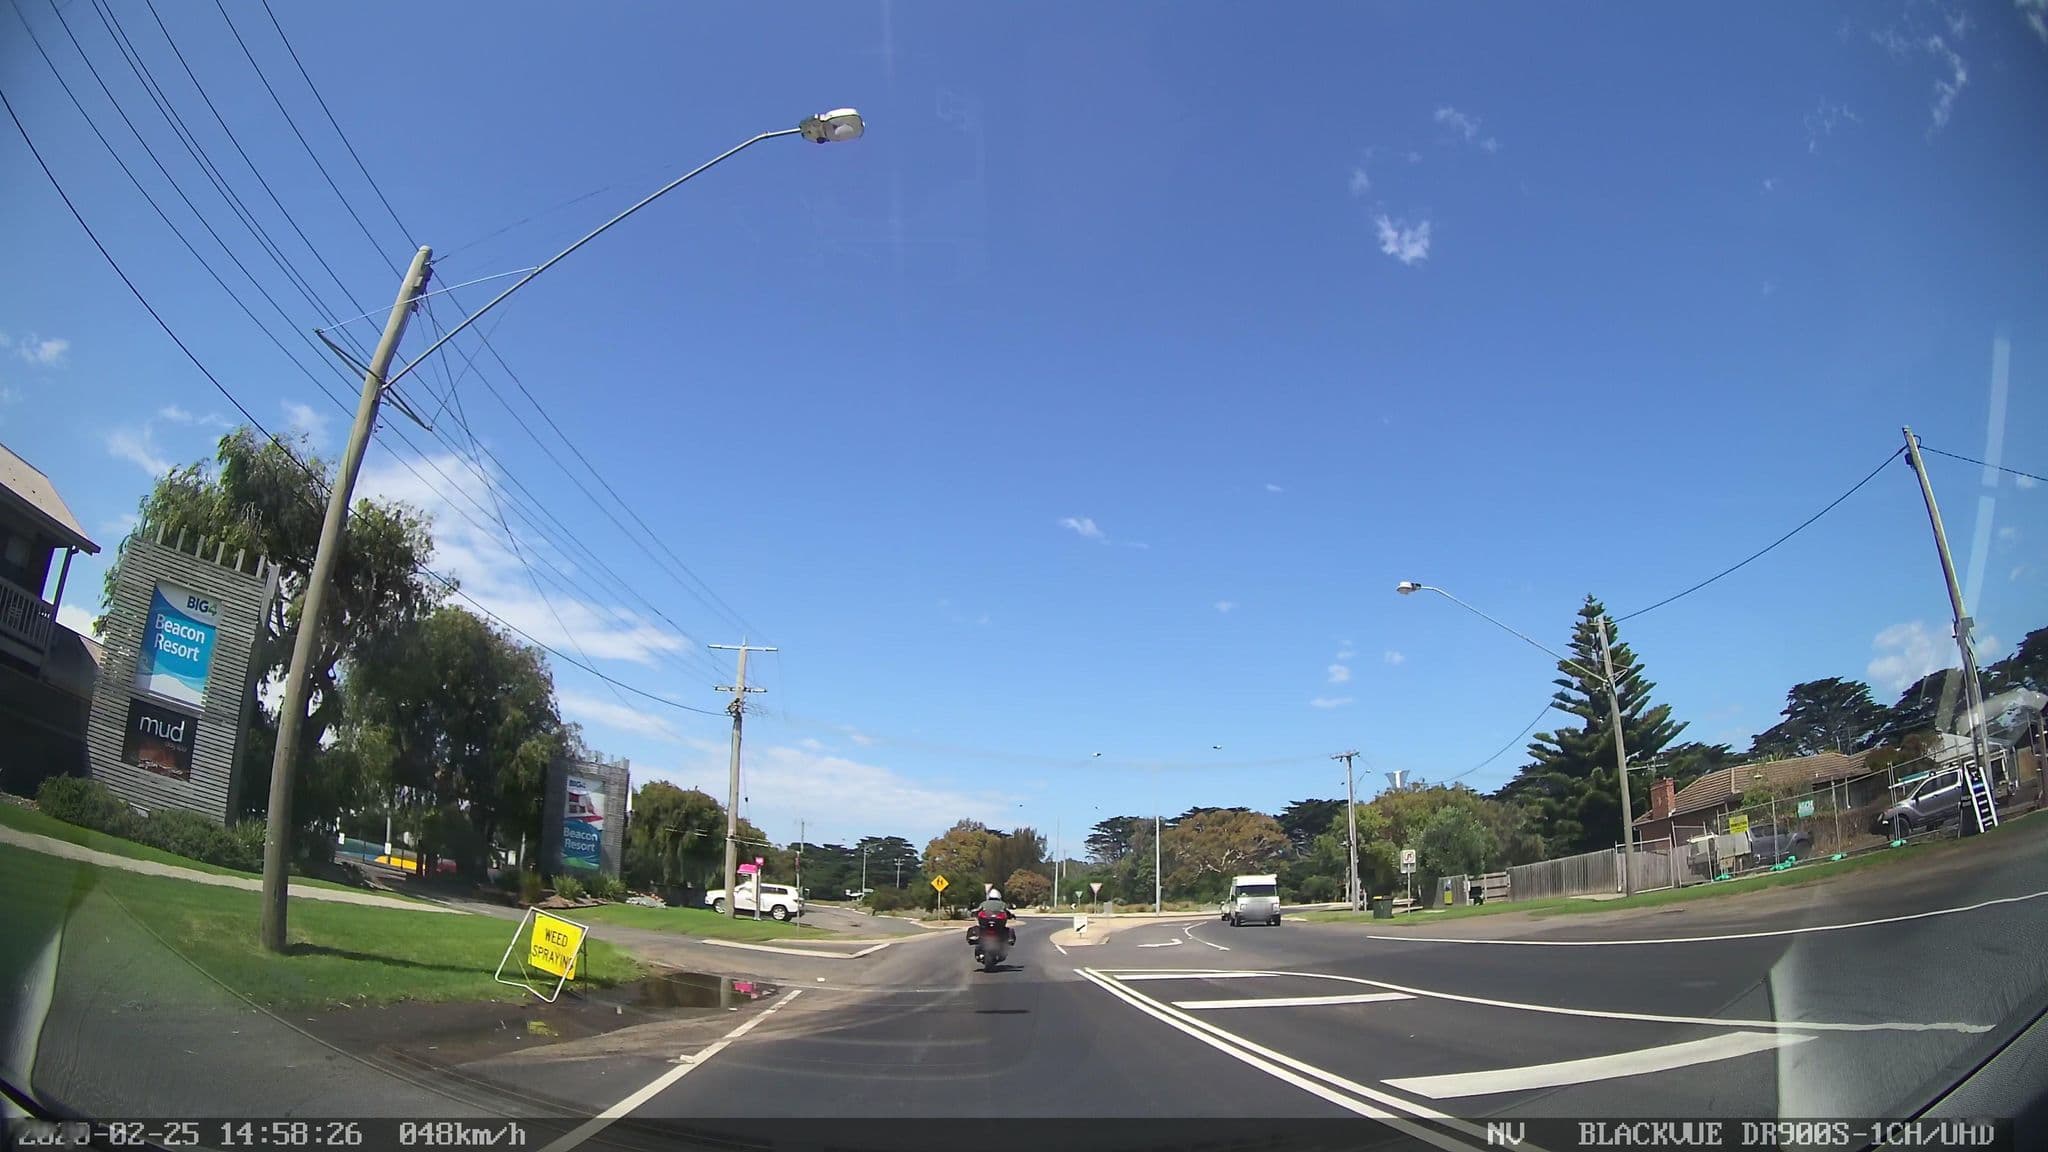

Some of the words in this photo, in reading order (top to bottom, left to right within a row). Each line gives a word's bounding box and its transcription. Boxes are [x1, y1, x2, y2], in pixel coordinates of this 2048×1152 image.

[187, 595, 218, 616] BIG4
[155, 613, 205, 644] Beacon
[154, 632, 200, 662] Resort
[139, 716, 185, 743] mud
[563, 826, 598, 841] Beacon
[564, 838, 596, 852] Resort
[545, 928, 569, 948] WEED
